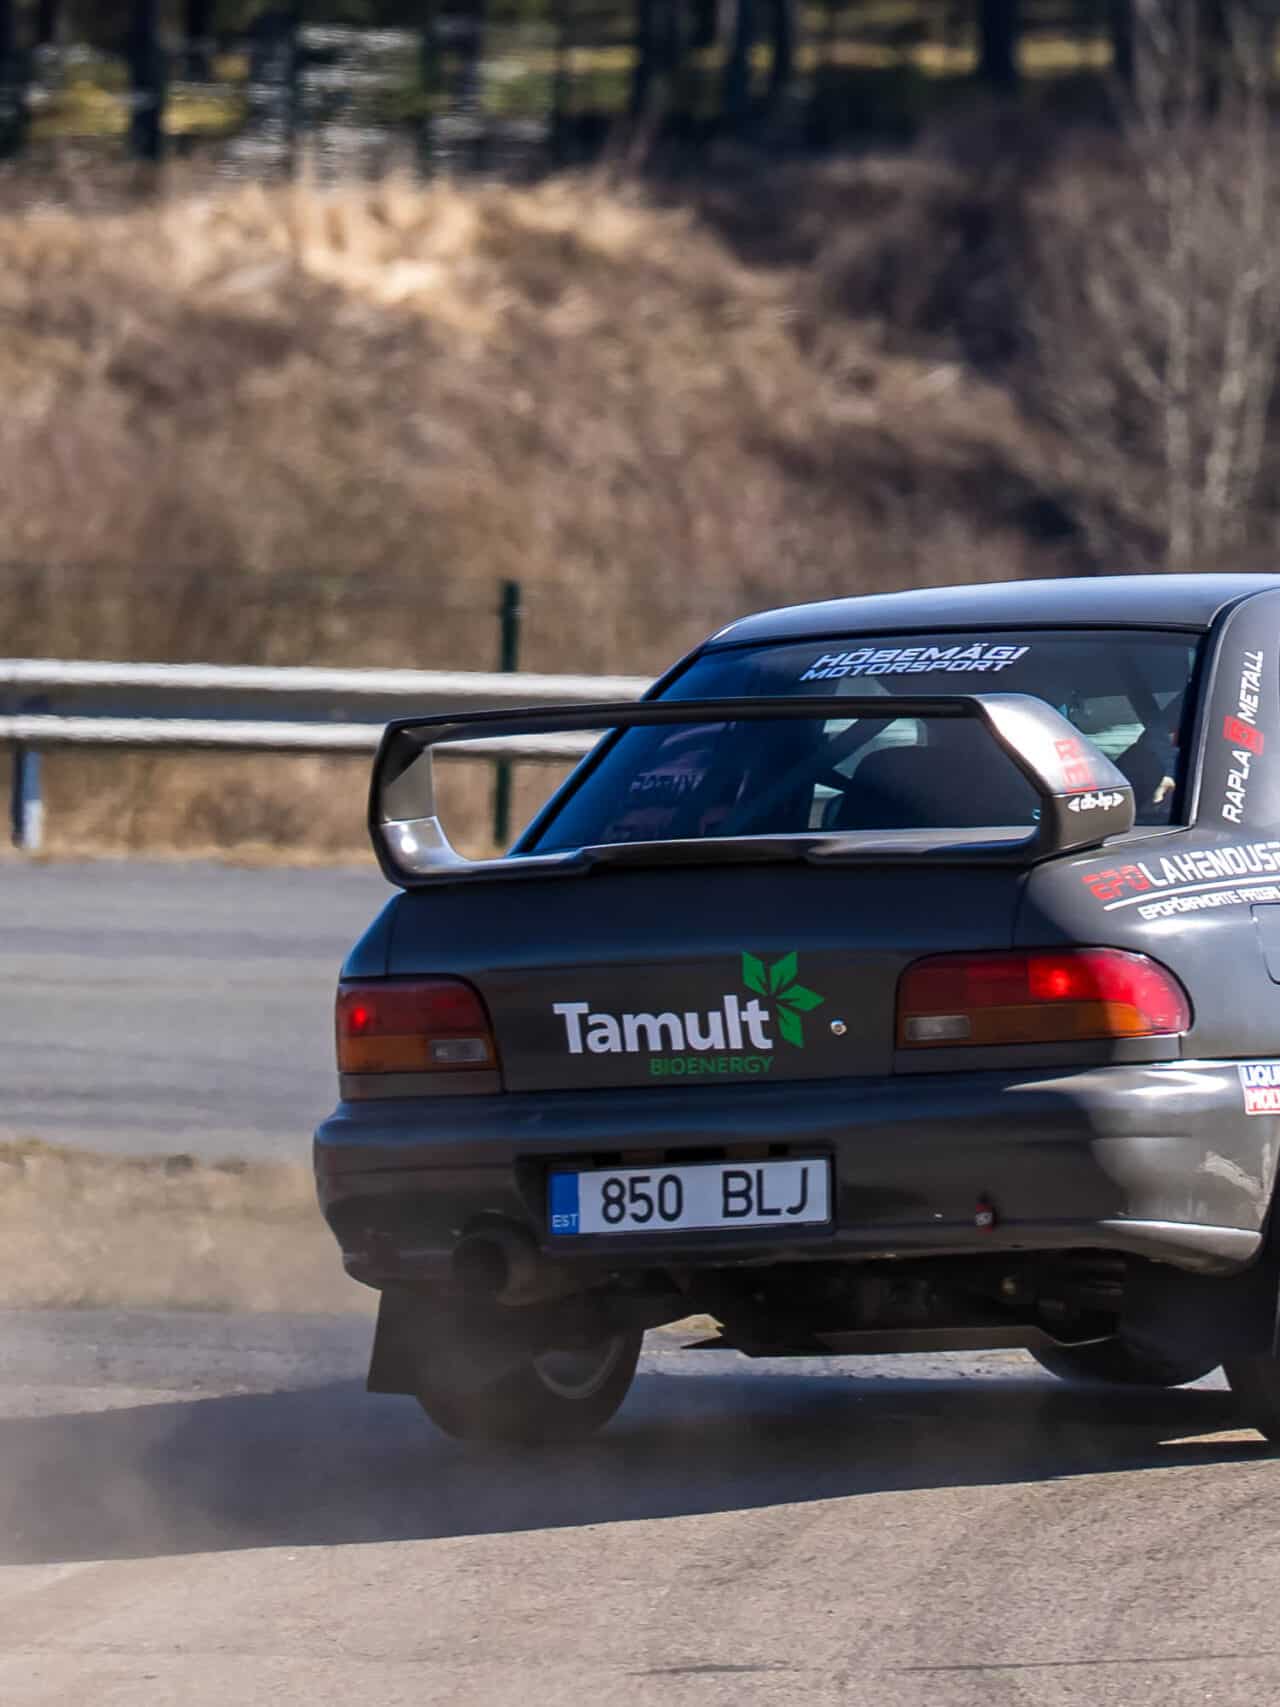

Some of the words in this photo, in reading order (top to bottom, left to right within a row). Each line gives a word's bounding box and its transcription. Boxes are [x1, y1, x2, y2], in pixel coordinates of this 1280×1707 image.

[800, 660, 1015, 681] MOTORSPORT
[811, 643, 1031, 669] HÕBEMÄGI
[1237, 650, 1264, 725] METALL
[1222, 750, 1253, 824] RAPLA
[552, 995, 774, 1054] Tamult
[650, 1055, 774, 1076] BIOENERGY
[601, 1174, 684, 1225] 850
[721, 1168, 809, 1219] BLJ
[552, 1213, 578, 1228] EST
